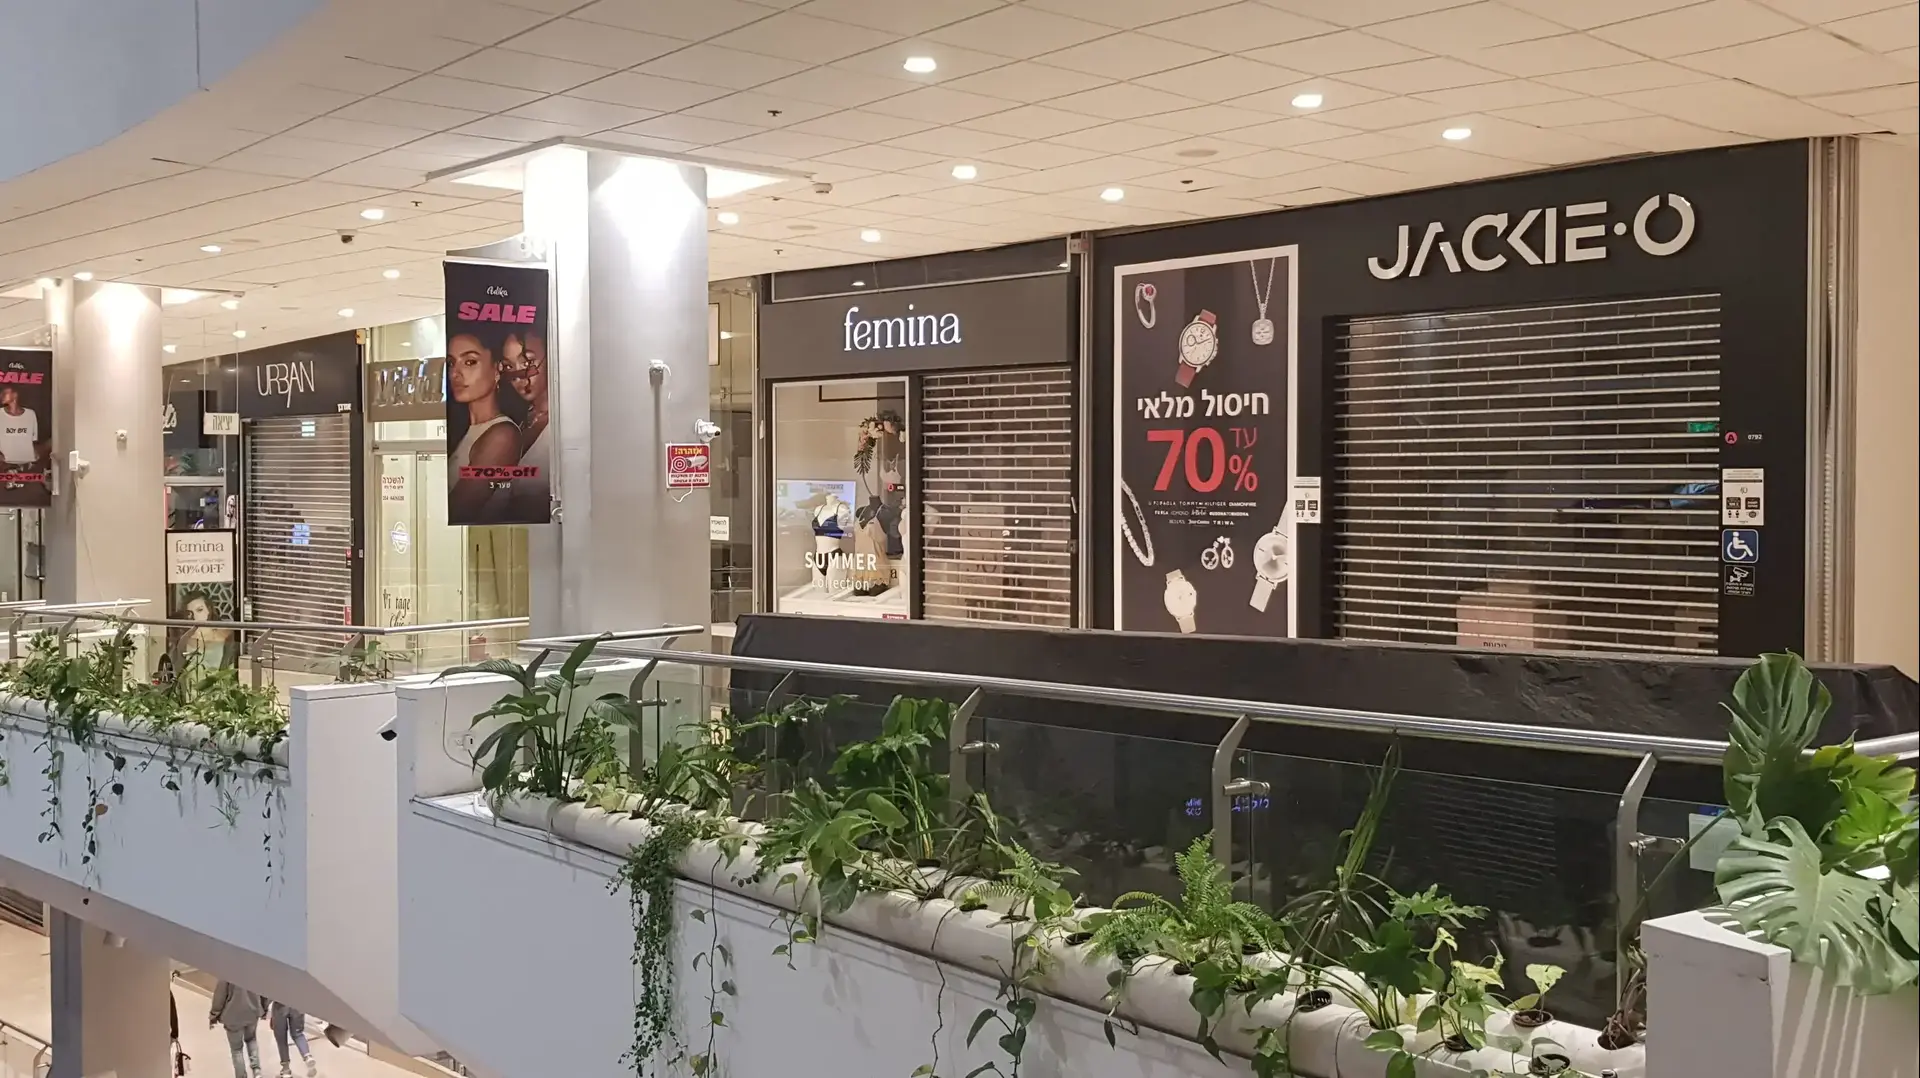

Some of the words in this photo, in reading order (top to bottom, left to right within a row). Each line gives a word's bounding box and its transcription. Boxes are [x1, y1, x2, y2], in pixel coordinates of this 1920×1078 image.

[486, 286, 508, 298] Adika
[458, 301, 537, 324] SALE
[843, 304, 962, 351] femina
[256, 360, 315, 409] URBAN
[1137, 391, 1194, 419] מלאי
[1201, 389, 1269, 417] חיסול
[212, 415, 233, 431] יציאה
[1229, 427, 1257, 449] עד
[674, 447, 703, 455] אזהרה!
[471, 467, 510, 477] 70%
[512, 467, 539, 477] off
[175, 539, 224, 553] femina
[175, 563, 200, 575] 30%
[200, 563, 225, 574] OFF
[805, 551, 877, 571] SUMMER
